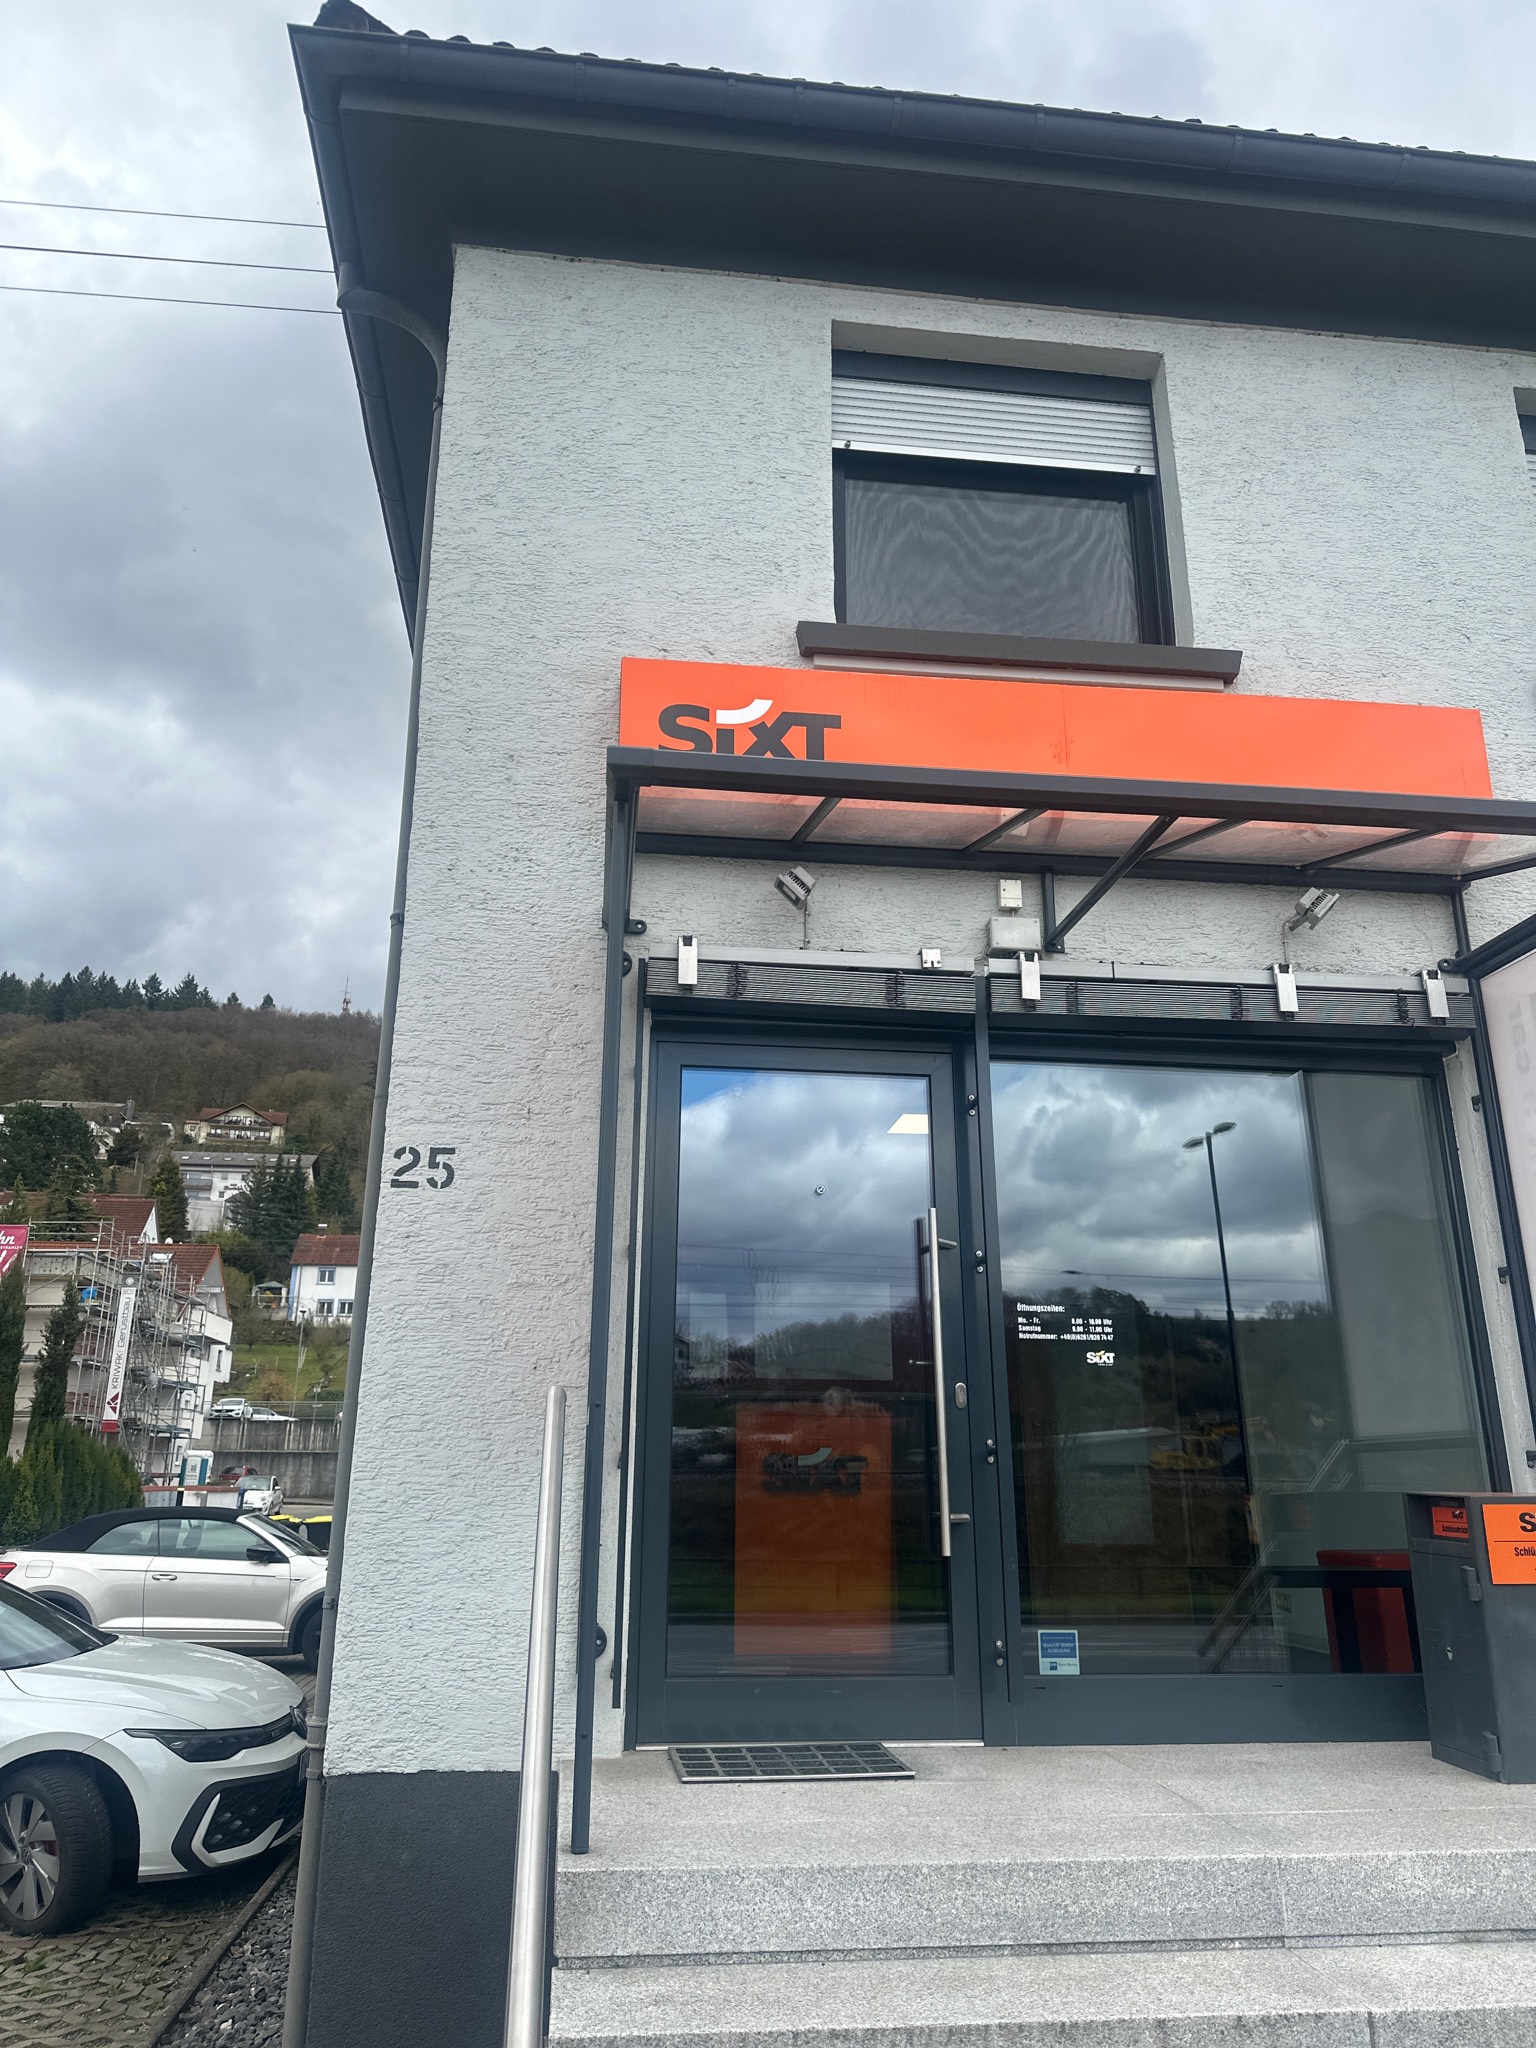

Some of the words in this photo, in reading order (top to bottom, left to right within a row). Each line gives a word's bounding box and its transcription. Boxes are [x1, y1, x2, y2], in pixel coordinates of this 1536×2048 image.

[391, 1146, 456, 1189] 25
[1016, 1302, 1065, 1312] Öffnungszeiten:
[1018, 1316, 1028, 1324] Mo.
[1033, 1316, 1041, 1324] Fr.
[1103, 1318, 1113, 1326] Uhr
[1019, 1332, 1058, 1340] Notrufnummer:
